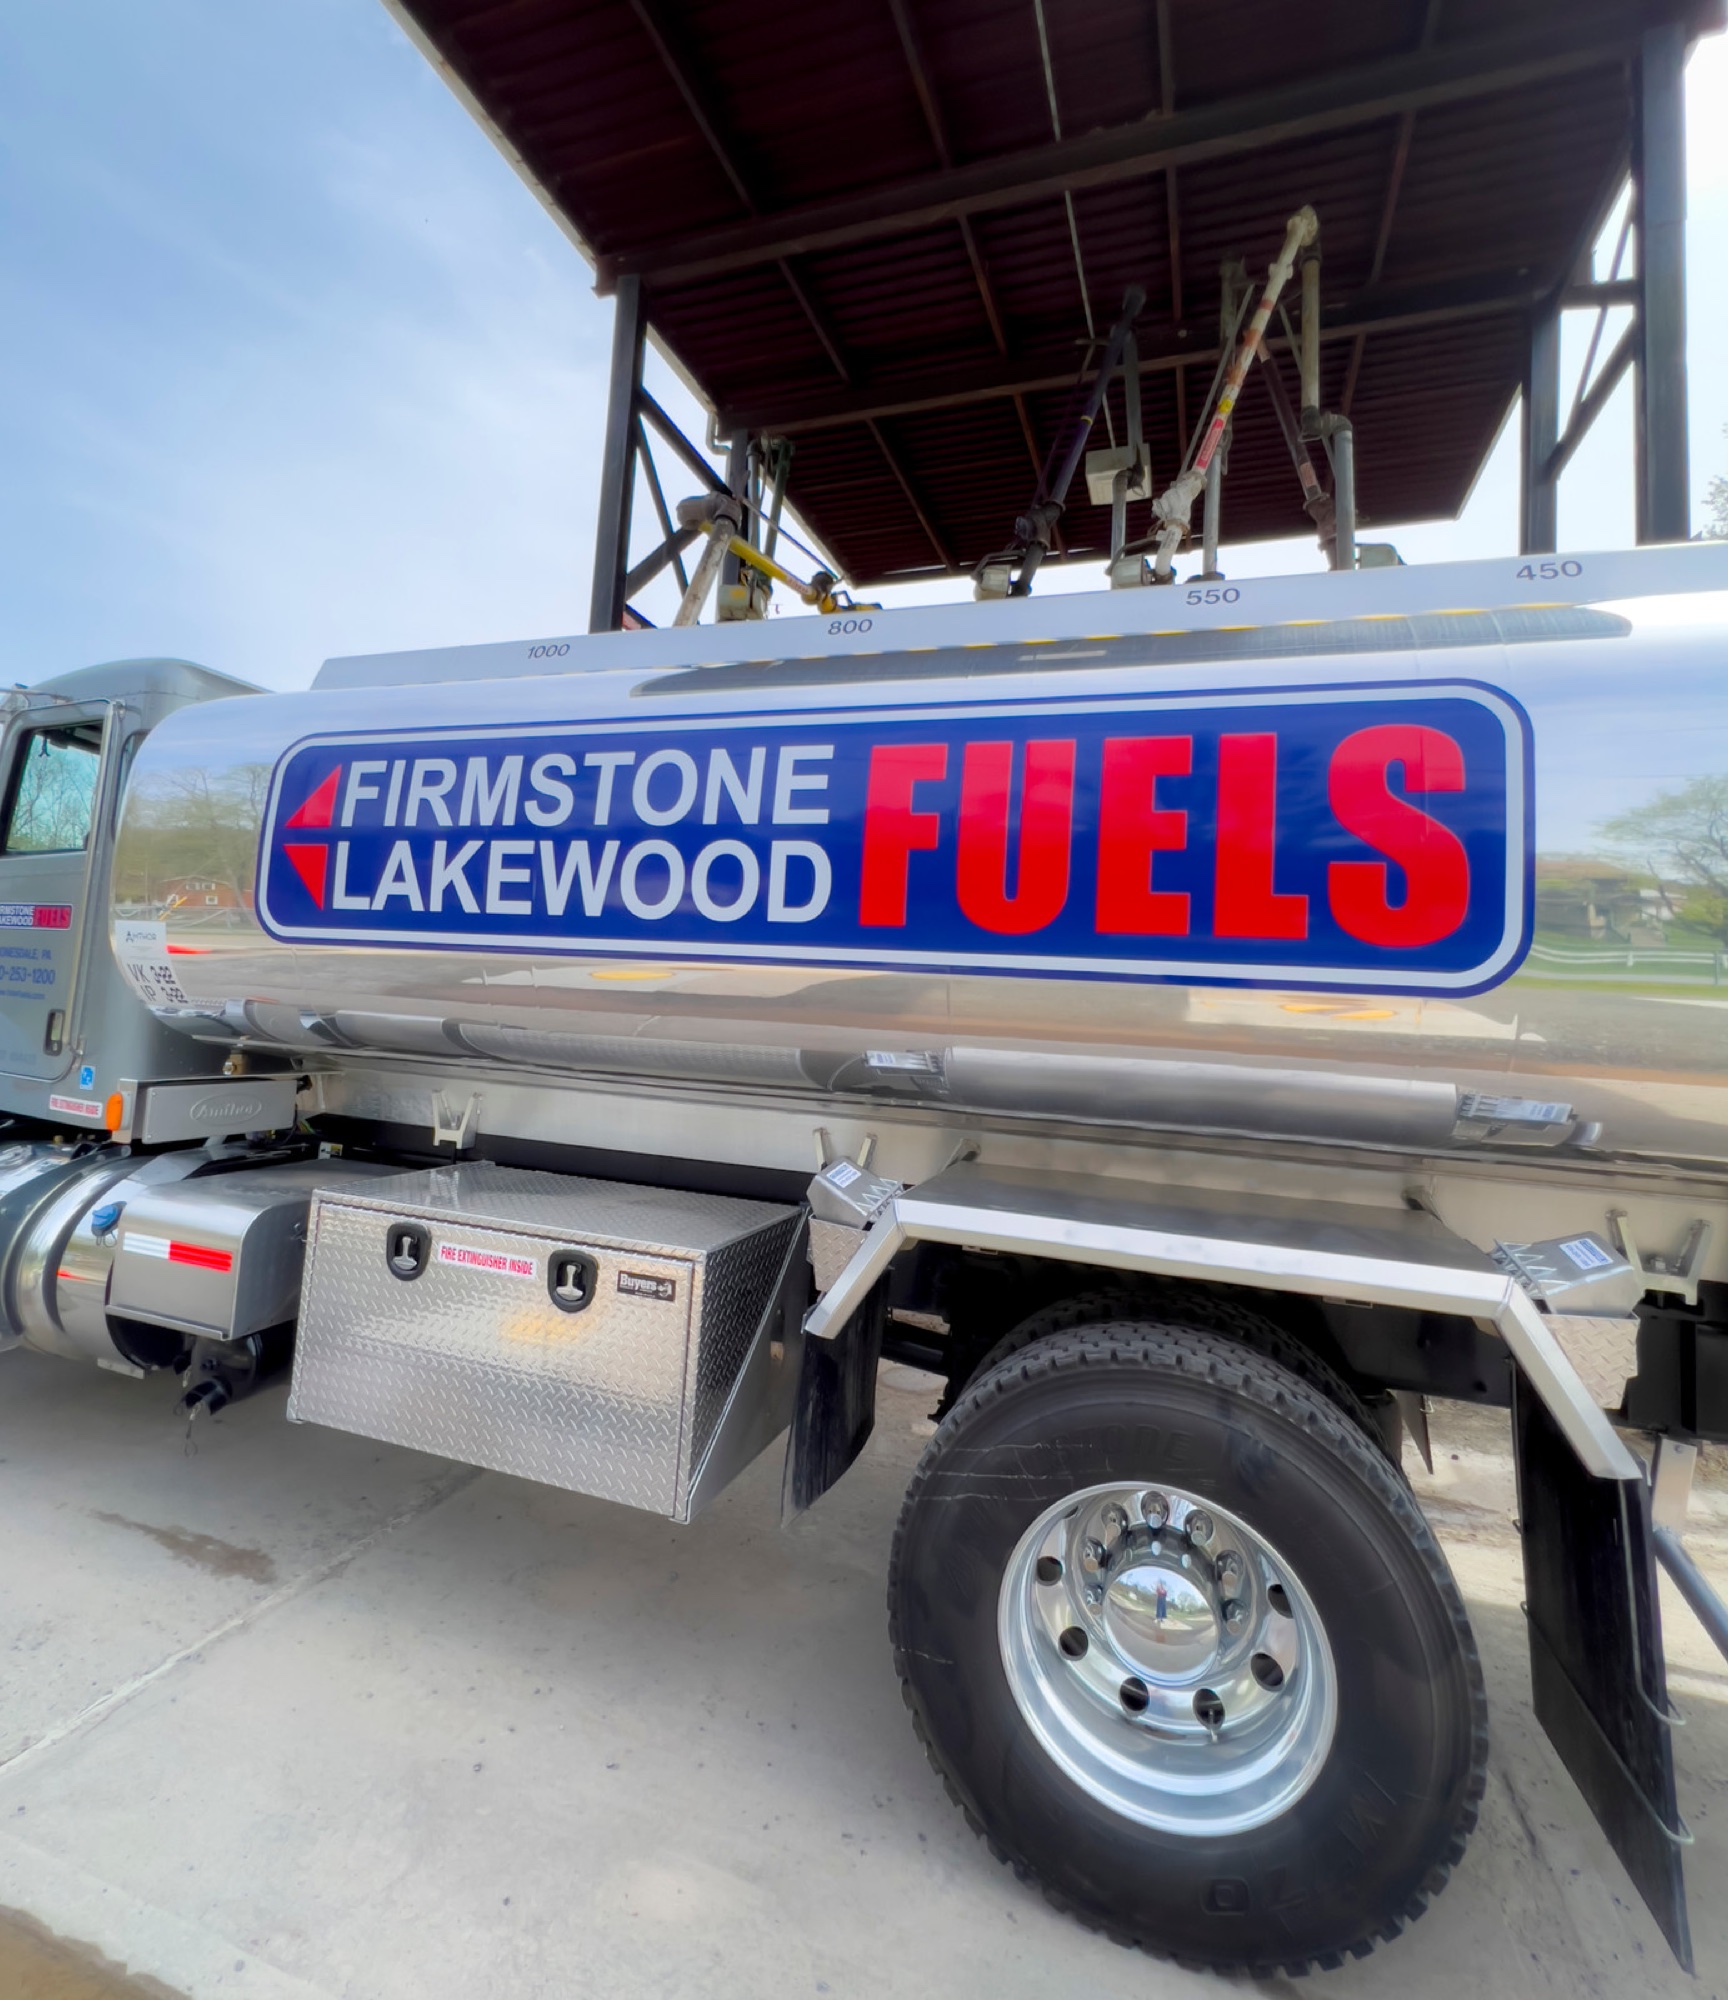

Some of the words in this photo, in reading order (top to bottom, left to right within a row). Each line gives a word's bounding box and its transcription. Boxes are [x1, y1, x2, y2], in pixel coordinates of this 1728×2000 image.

[1516, 560, 1583, 581] 450
[1186, 588, 1241, 606] 550
[827, 619, 872, 635] 800
[527, 644, 570, 659] 1000
[340, 744, 835, 827] FIRMSTONE
[858, 724, 1470, 949] FUELS
[332, 839, 832, 922] LAKEWOOD
[441, 1245, 457, 1261] FIRE
[458, 1249, 507, 1270] EXTINGUISHER
[508, 1258, 533, 1275] INSIDE
[620, 1273, 657, 1290] Buyers
